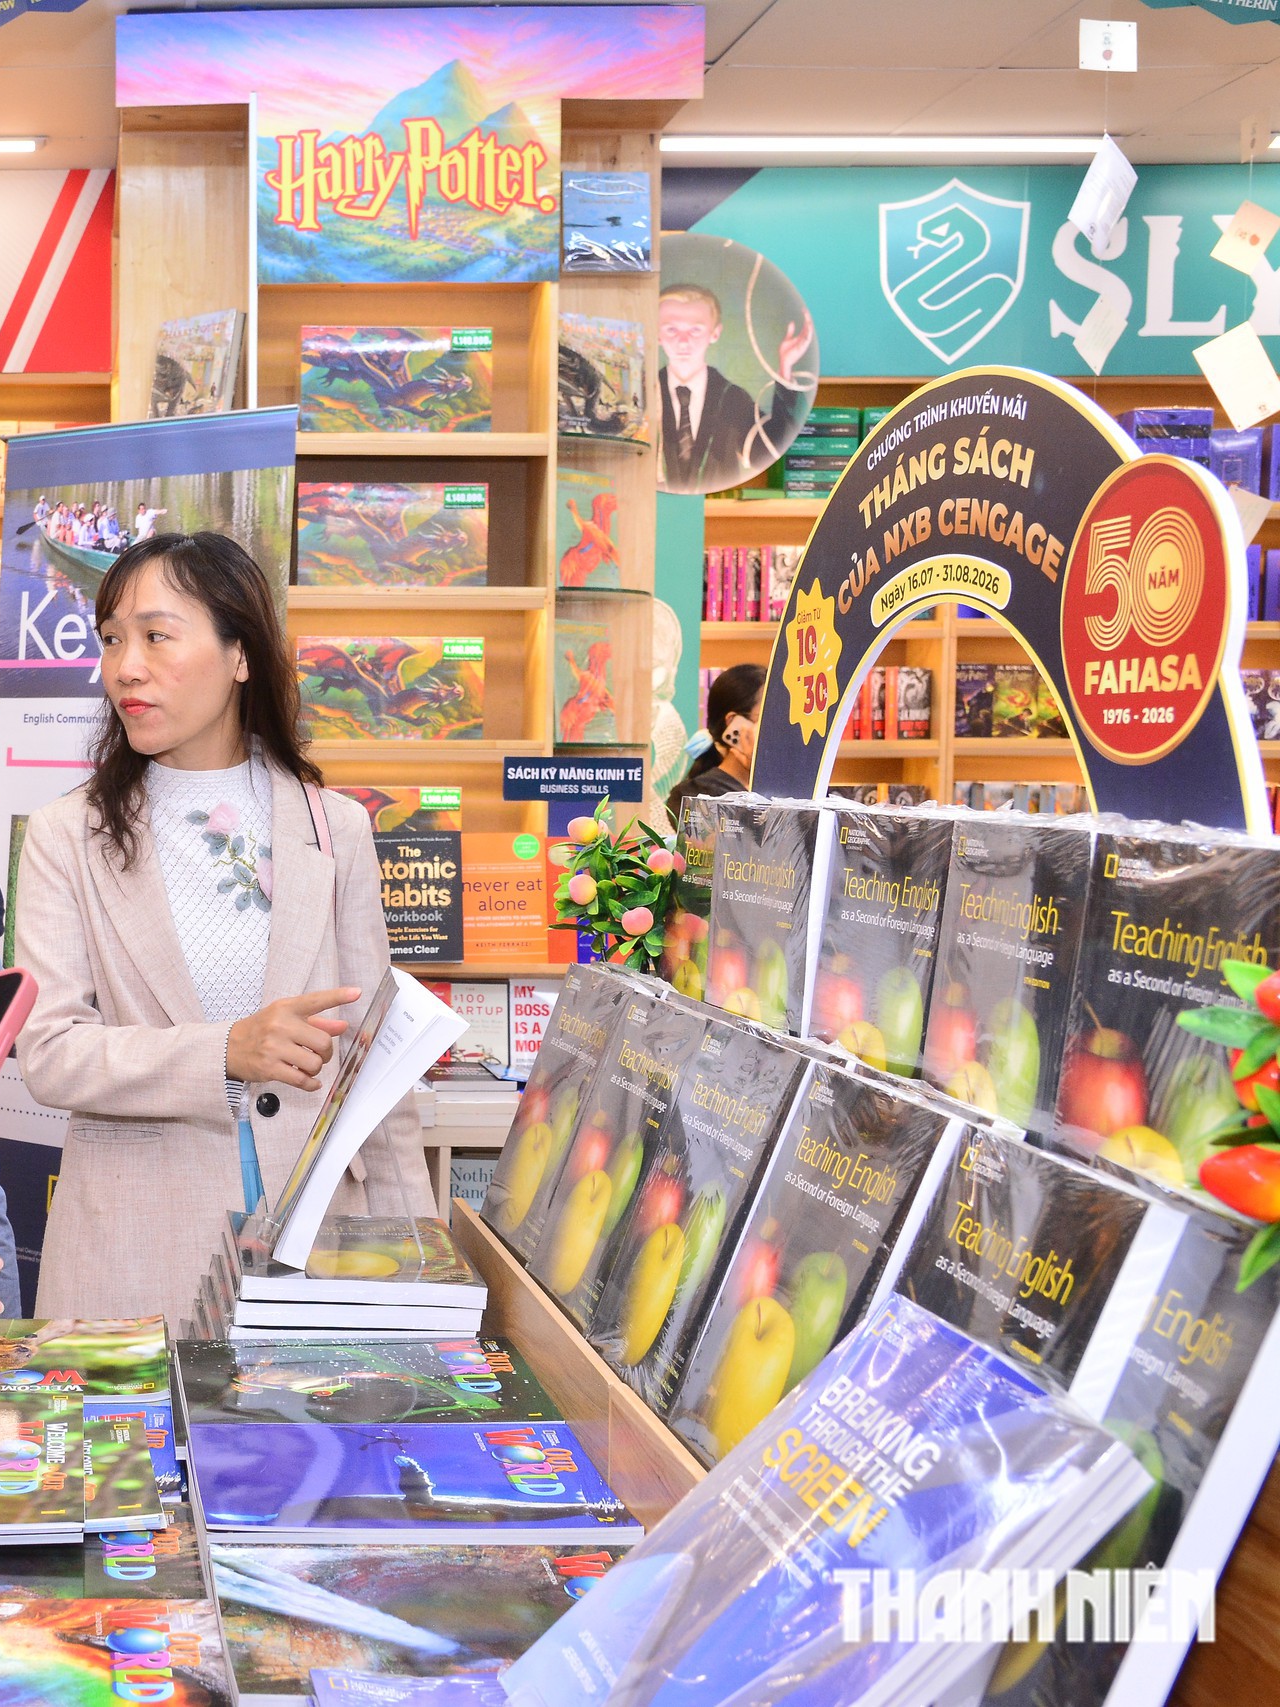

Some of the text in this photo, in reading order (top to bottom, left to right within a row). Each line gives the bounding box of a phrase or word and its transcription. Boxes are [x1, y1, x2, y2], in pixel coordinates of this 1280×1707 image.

[265, 129, 406, 231] Harry
[867, 388, 1027, 471] CHƯƠNG TRÌNH KHUYẾN MÃI
[858, 442, 947, 529] THÁNG
[952, 426, 1035, 489] SÁCH
[838, 498, 1065, 615] CỦA NXB CENGAGE
[881, 582, 906, 612] Ngày
[908, 567, 933, 592] 16.07
[942, 564, 1000, 595] 31.08.2026
[1084, 506, 1206, 652] 50
[1148, 567, 1180, 590] NĂM
[1084, 653, 1203, 696] FAHASA
[23, 713, 55, 725] English
[1103, 708, 1133, 726] 1976
[1141, 706, 1175, 725] 2026
[507, 765, 642, 781] SÁCH KỸ NĂNG KINH TẾ
[540, 784, 609, 795] BUSINESS SKILLS
[397, 845, 422, 857] The
[848, 828, 867, 838] NATIONAL
[462, 878, 543, 893] never eat
[722, 853, 770, 891] Teaching
[478, 895, 527, 911] alone
[734, 890, 758, 904] Second
[843, 867, 940, 917] Teaching English
[841, 909, 935, 940] as Second Foreign Language
[960, 883, 1059, 940] Teaching English
[390, 945, 440, 955] ames Clear
[1015, 945, 1054, 968] Language
[1111, 910, 1204, 978] Teaching
[454, 993, 485, 1003] $100
[514, 985, 535, 998] MY
[1107, 967, 1183, 996] as a Second or
[515, 1003, 550, 1016] BOSS
[515, 1022, 528, 1034] IS
[532, 1022, 541, 1034] A
[618, 1039, 656, 1086] Teaching
[690, 1074, 734, 1127] Teaching
[733, 1095, 767, 1137] English
[794, 1125, 898, 1206] Teaching English
[796, 1174, 880, 1233] Second Foreign Language
[949, 1201, 1012, 1280] Teaching
[1006, 1236, 1075, 1306] English
[1008, 1299, 1056, 1339] Language
[483, 1351, 515, 1373] OUR
[819, 1374, 942, 1483] BREAKING
[42, 1422, 68, 1491] WELCOME OUR
[541, 1447, 579, 1473] OUR
[798, 1402, 914, 1508] THROUGH THE
[762, 1427, 889, 1549] SCREEN
[165, 1631, 203, 1668] OUR
